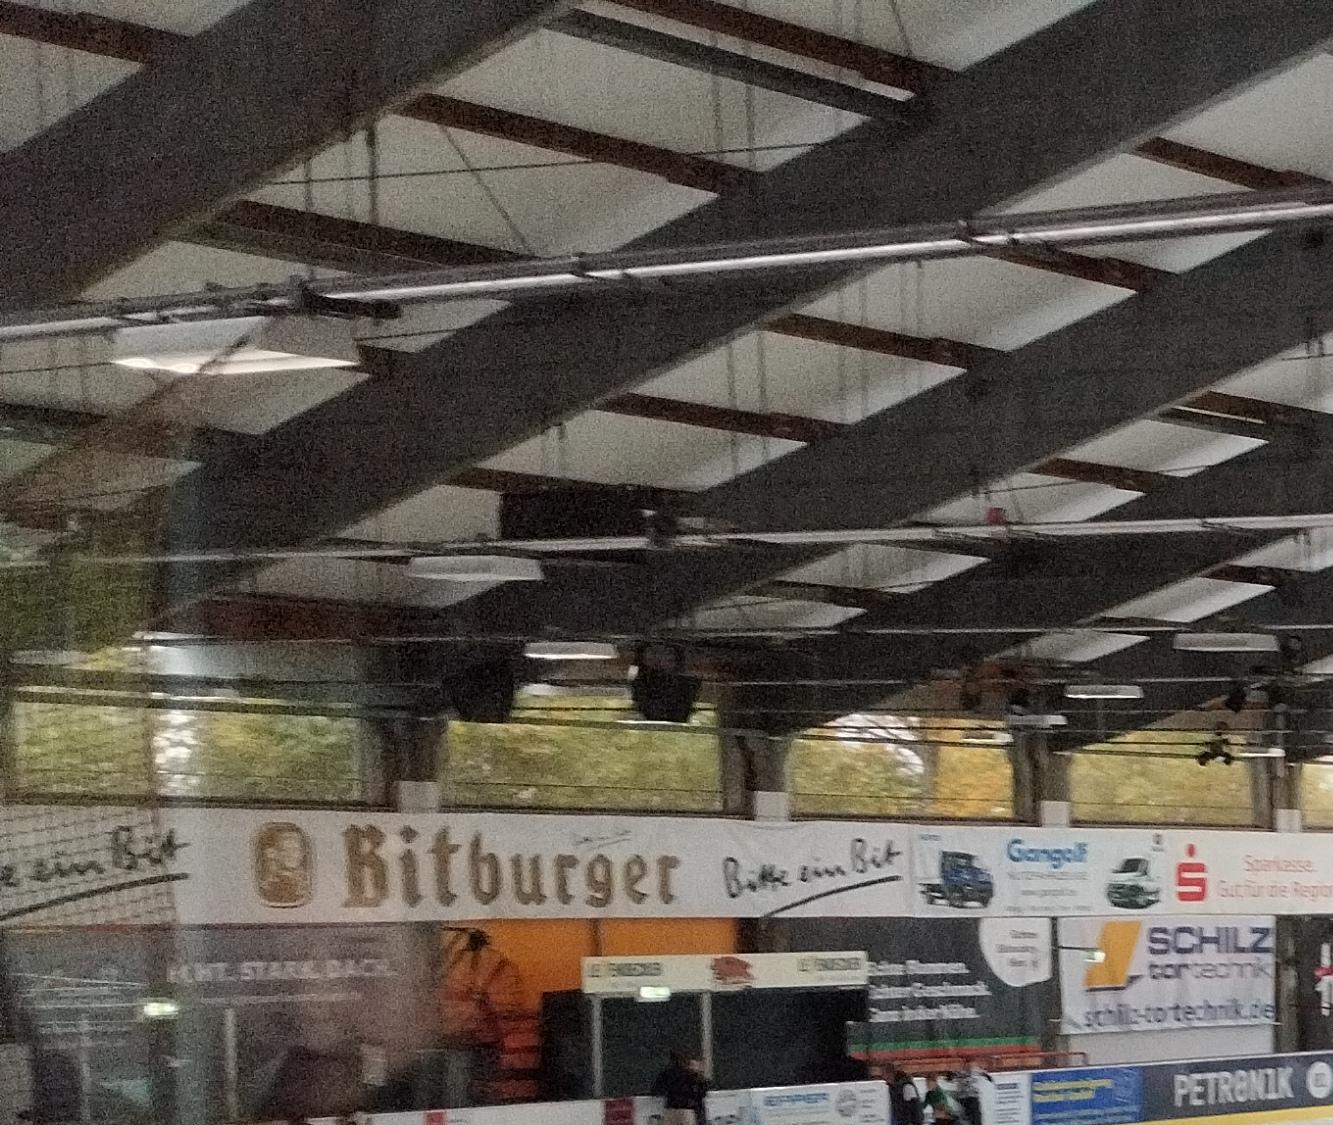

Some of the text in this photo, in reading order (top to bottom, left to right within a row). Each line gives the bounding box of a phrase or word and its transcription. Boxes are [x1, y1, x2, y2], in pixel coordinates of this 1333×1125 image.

[342, 823, 681, 907] Bitburger
[722, 856, 790, 899] Bitte
[852, 838, 902, 873] Bit
[1007, 838, 1089, 869] Gangolf
[1148, 926, 1273, 954] SCHILZ
[1148, 957, 1271, 980] tortechnik
